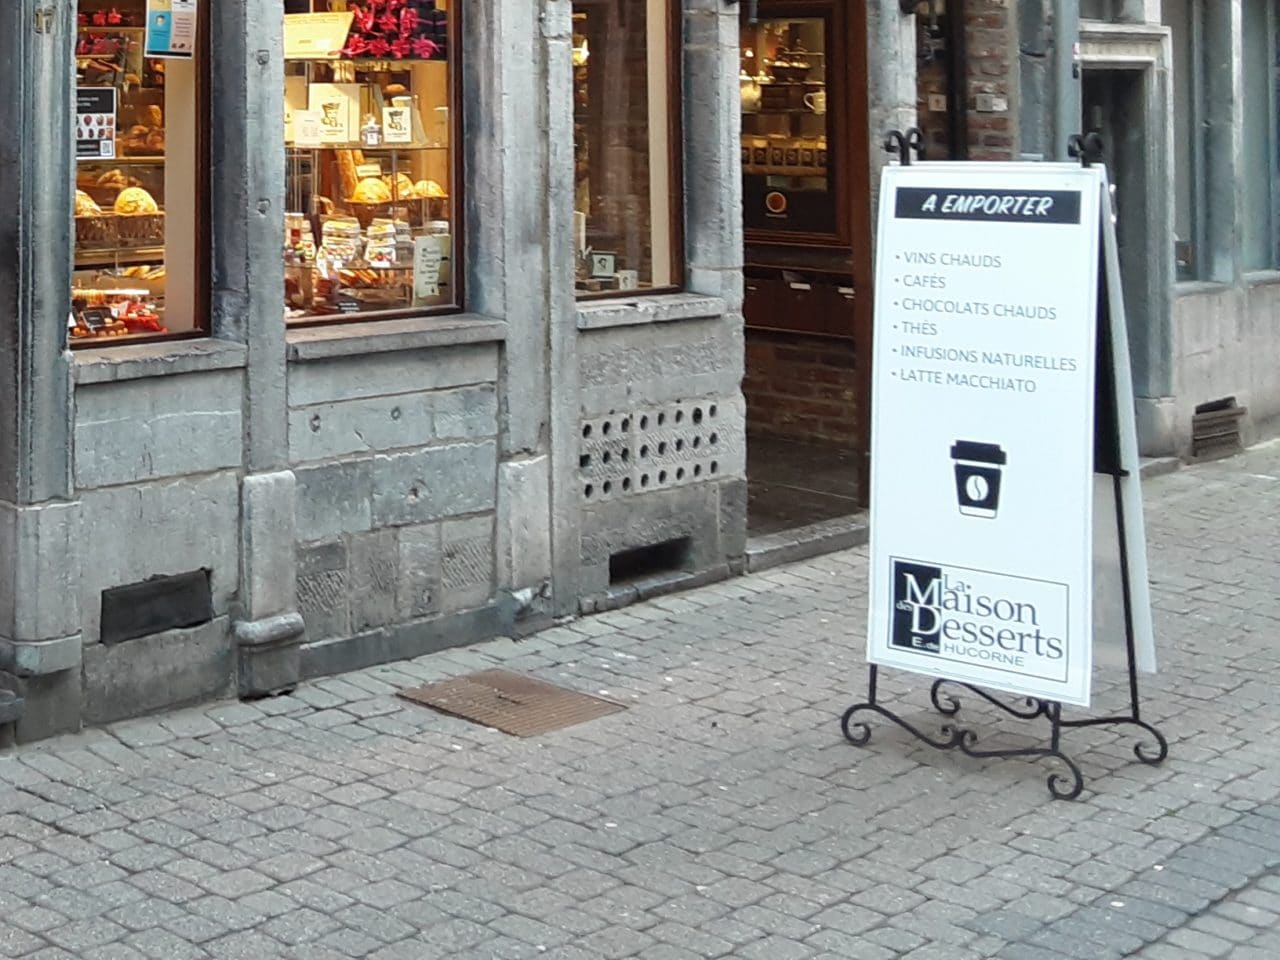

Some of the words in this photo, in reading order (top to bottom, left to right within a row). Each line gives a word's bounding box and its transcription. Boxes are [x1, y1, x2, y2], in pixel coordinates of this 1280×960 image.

[922, 194, 936, 213] A
[941, 194, 1054, 216] EMPORTER
[904, 251, 937, 265] VINS
[940, 252, 1002, 268] CHAUDS
[903, 272, 947, 289] CAFÉS
[902, 298, 990, 316] CHOCOLATS
[993, 304, 1057, 320] CHAUDS
[901, 319, 938, 336] THÉS
[900, 345, 978, 363] INFUSIONS
[981, 350, 1077, 372] NATURELLES
[900, 368, 942, 385] LATTE
[946, 372, 1037, 393] MACCHIATO
[943, 573, 966, 593] La
[902, 572, 1041, 627] Maison
[910, 605, 1064, 660] Desserts
[943, 643, 1025, 667] HUCORNE
